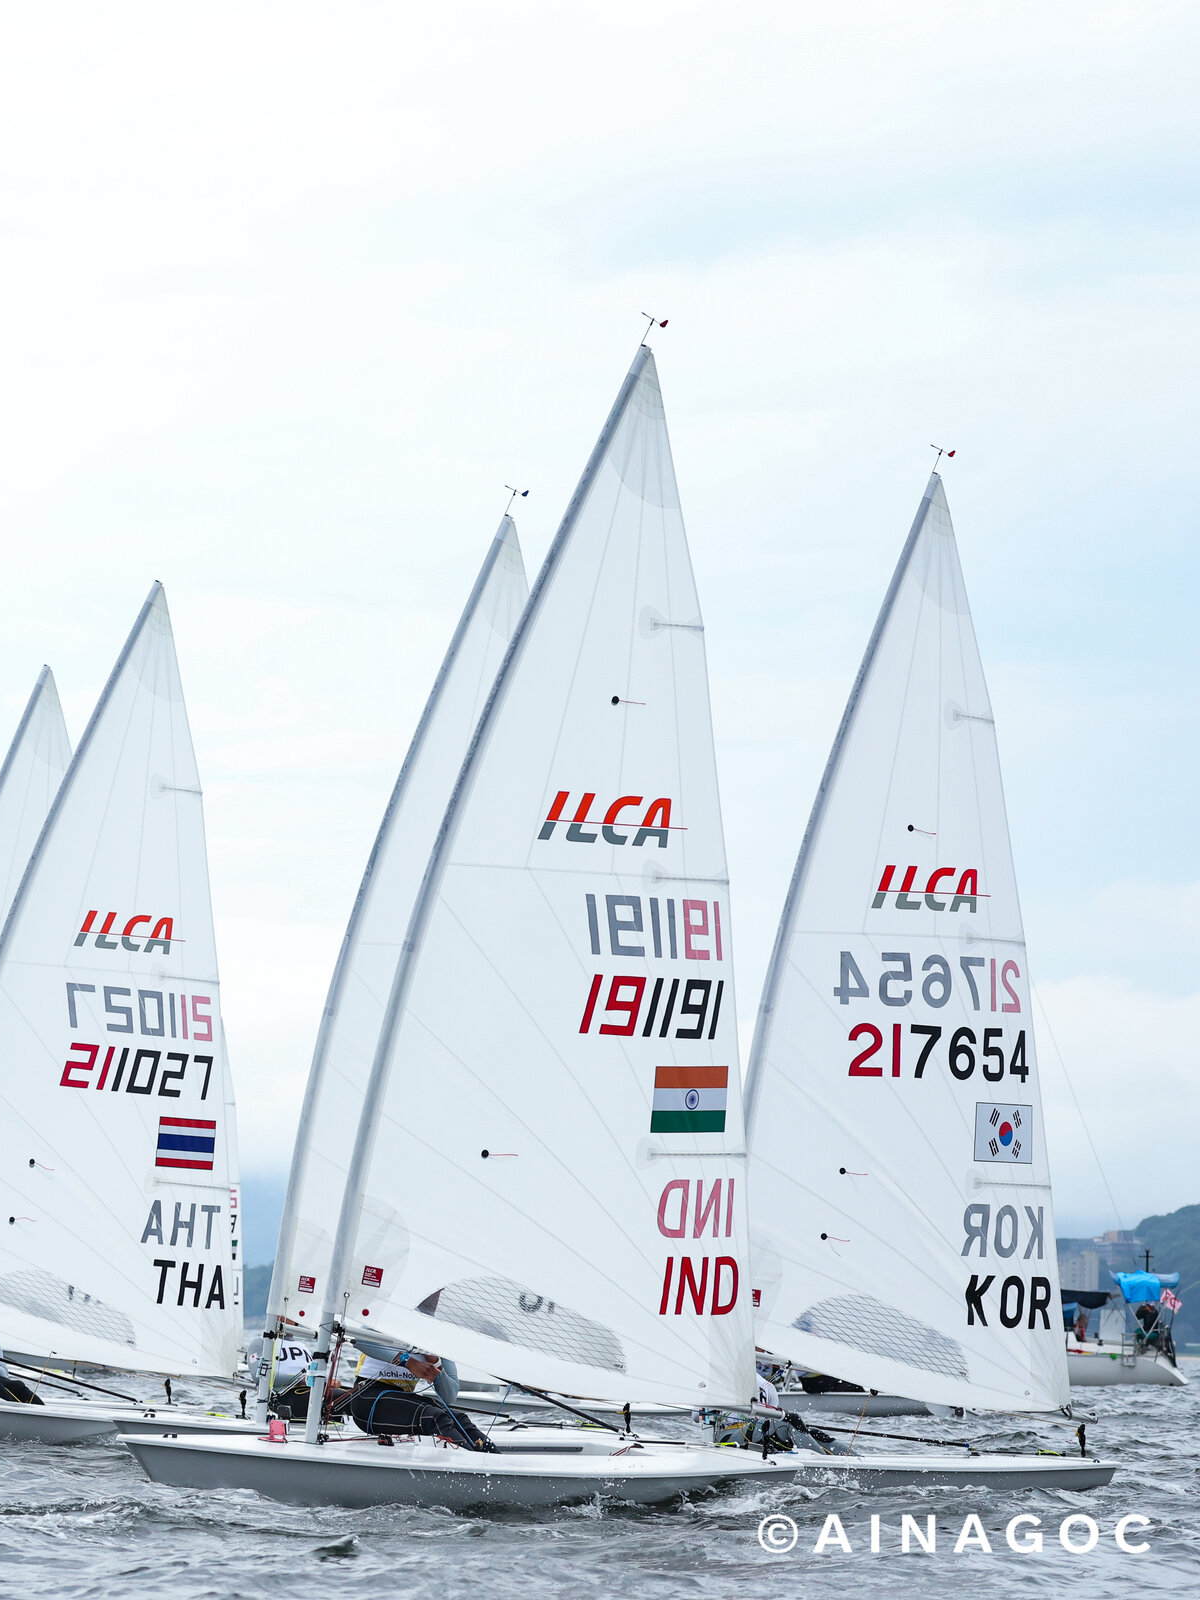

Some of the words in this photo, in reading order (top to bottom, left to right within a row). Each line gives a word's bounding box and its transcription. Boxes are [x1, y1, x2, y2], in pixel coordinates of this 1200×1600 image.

[538, 791, 672, 848] ILCA
[871, 865, 978, 914] ILCA
[74, 910, 174, 955] ILCA
[579, 974, 724, 1039] 191191
[59, 1042, 214, 1100] 211027
[848, 1023, 1030, 1083] 217654
[154, 1259, 225, 1310] THA
[659, 1256, 739, 1316] IND
[966, 1274, 1052, 1329] KOR
